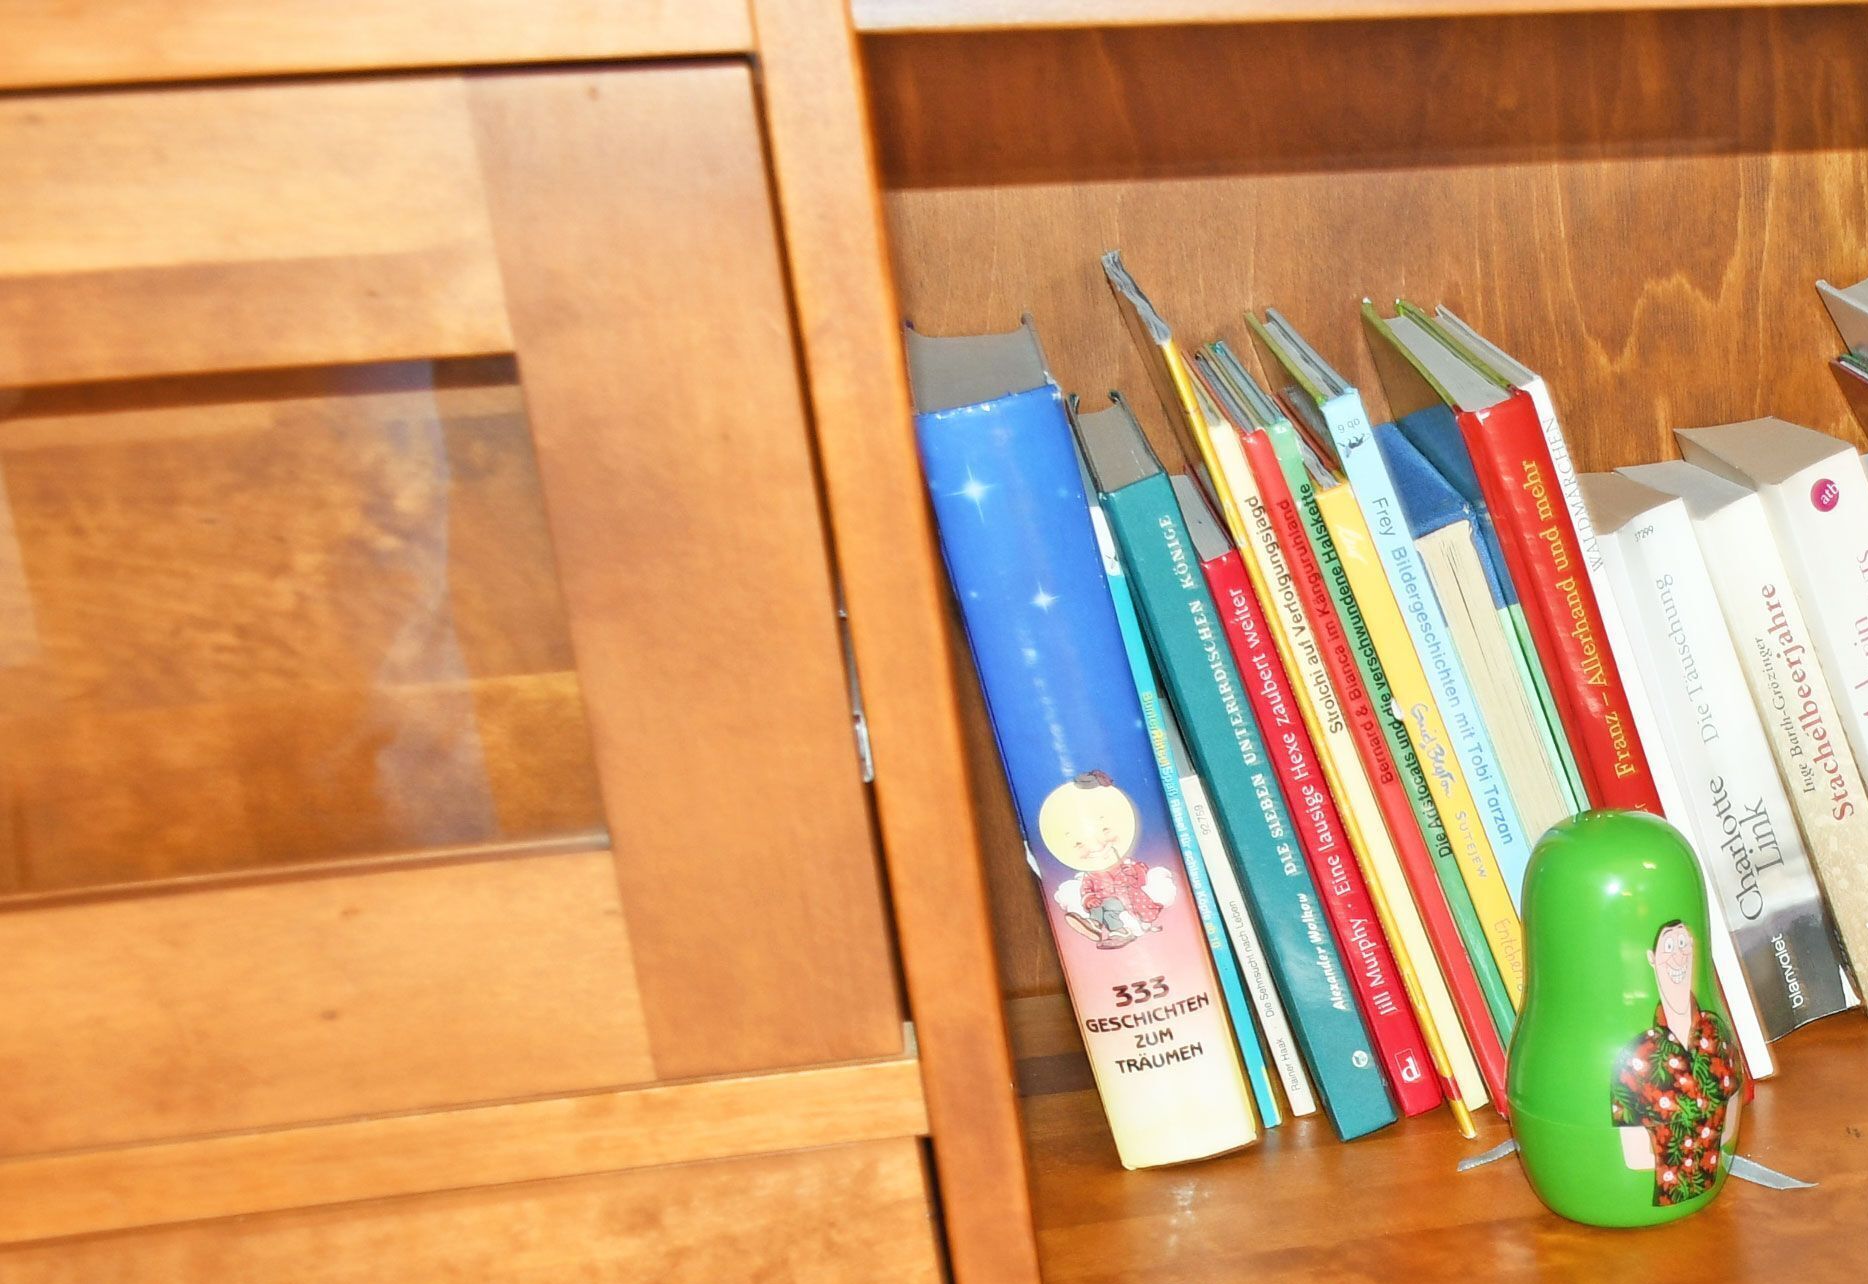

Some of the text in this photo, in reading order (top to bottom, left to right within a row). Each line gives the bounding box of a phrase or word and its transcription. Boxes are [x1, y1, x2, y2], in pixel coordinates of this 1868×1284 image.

[1542, 416, 1604, 572] WALDMÄRCHEN
[1246, 496, 1343, 734] Strolchi auf Verfolgungsjagd
[1279, 500, 1394, 785] Bernard & Bianca im Känguruhland
[1300, 483, 1451, 859] Die Aristocats und die verschwundene Halskette
[1372, 496, 1514, 845] Frey Bildergeschichten mit Tobi Tarzan
[1522, 459, 1636, 780] Franz Allerhand und mehr
[1655, 573, 1720, 745] Die Täuschung
[1159, 514, 1301, 877] DIE SIEBEN UNTERIRDISCHEN KÖNIGE
[1229, 587, 1351, 897] Eine lausige Hexe zaubert weiter
[1755, 636, 1817, 795] Inge Barth-Grözinger
[1761, 583, 1855, 821] Stachelbeerjahre
[1709, 775, 1764, 922] Charlotte
[1743, 796, 1785, 878] Link
[1086, 992, 1210, 1033] GESCHICHTEN
[1112, 976, 1170, 1007] 333
[1229, 900, 1275, 1018] Die Sehnsucht nach Leben
[1296, 893, 1348, 1012] Alexander Wolkow
[1349, 917, 1399, 1017] Jill Murphy
[1771, 932, 1804, 1010] blanvalet
[1115, 1042, 1204, 1074] TRÄUMEN
[1134, 1028, 1174, 1049] ZUM
